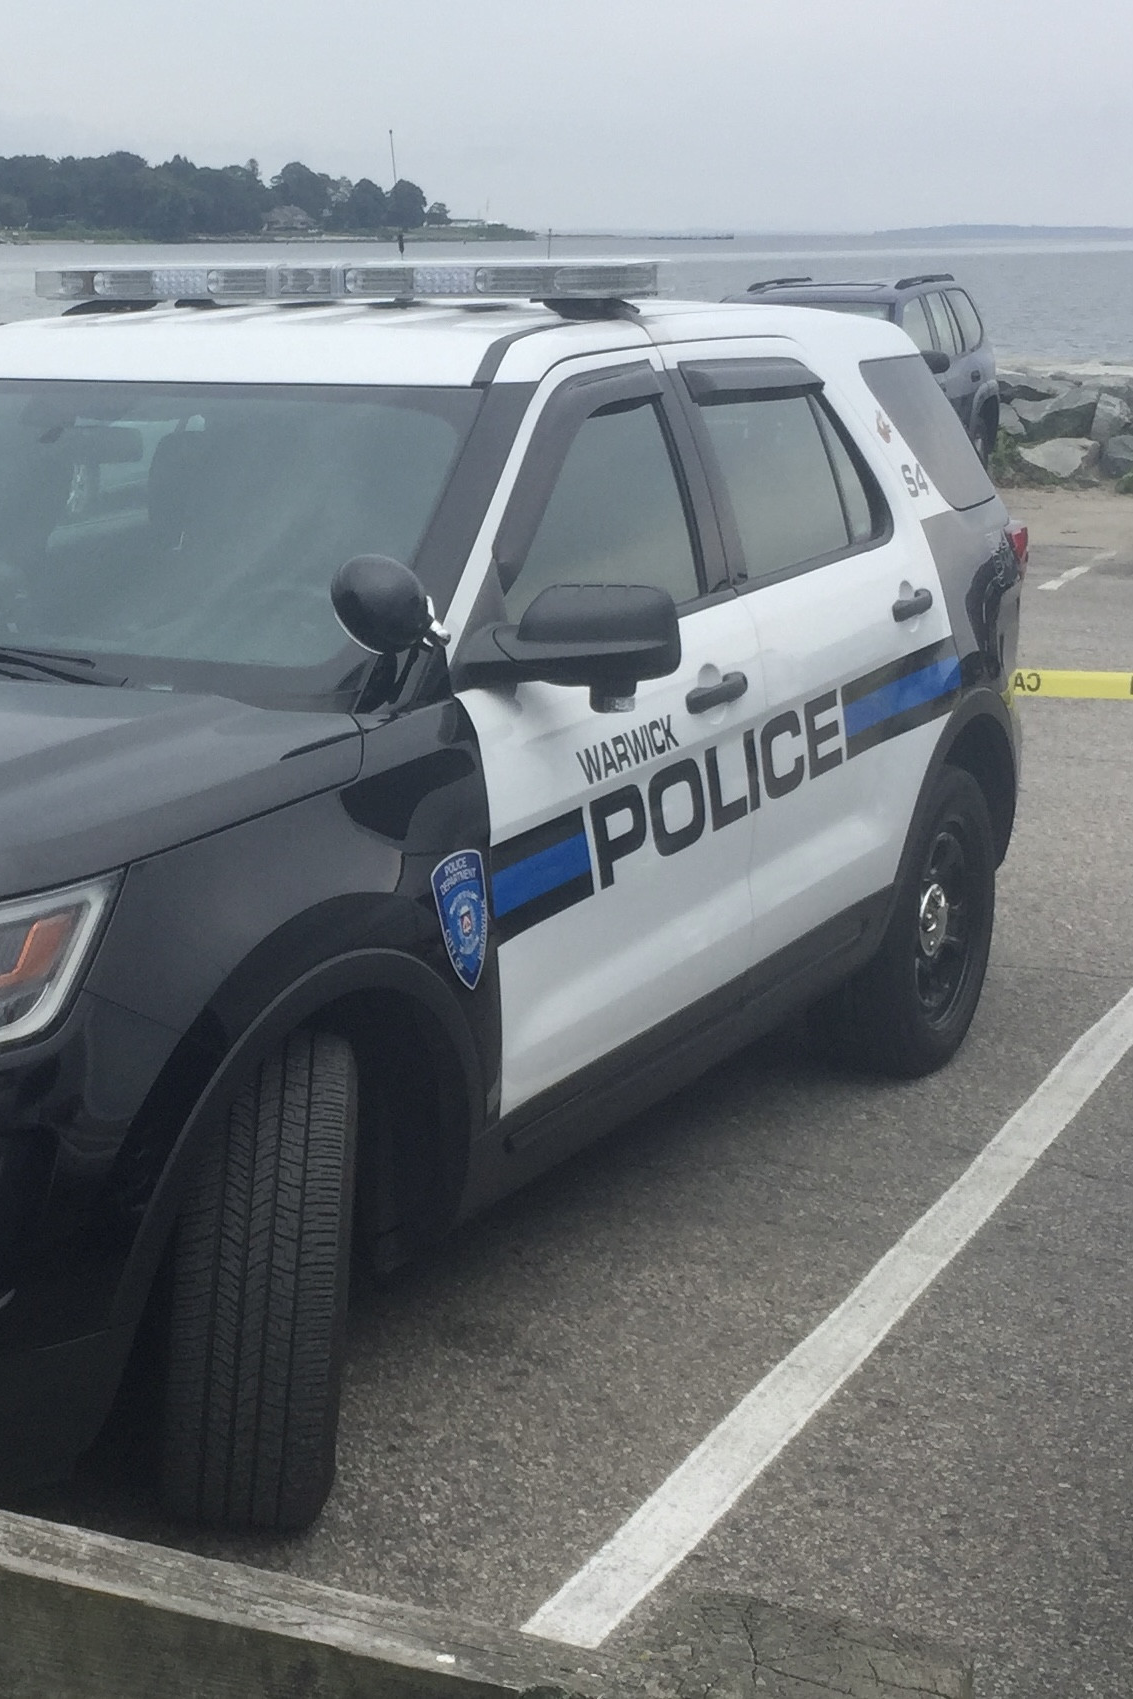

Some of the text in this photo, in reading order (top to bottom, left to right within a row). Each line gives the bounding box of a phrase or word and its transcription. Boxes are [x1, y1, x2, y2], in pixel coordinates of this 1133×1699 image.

[901, 463, 929, 498] S4
[576, 715, 679, 784] WARWICK
[590, 689, 843, 890] POLICE
[439, 867, 477, 896] DEPARTMENT
[444, 857, 467, 876] POLICE
